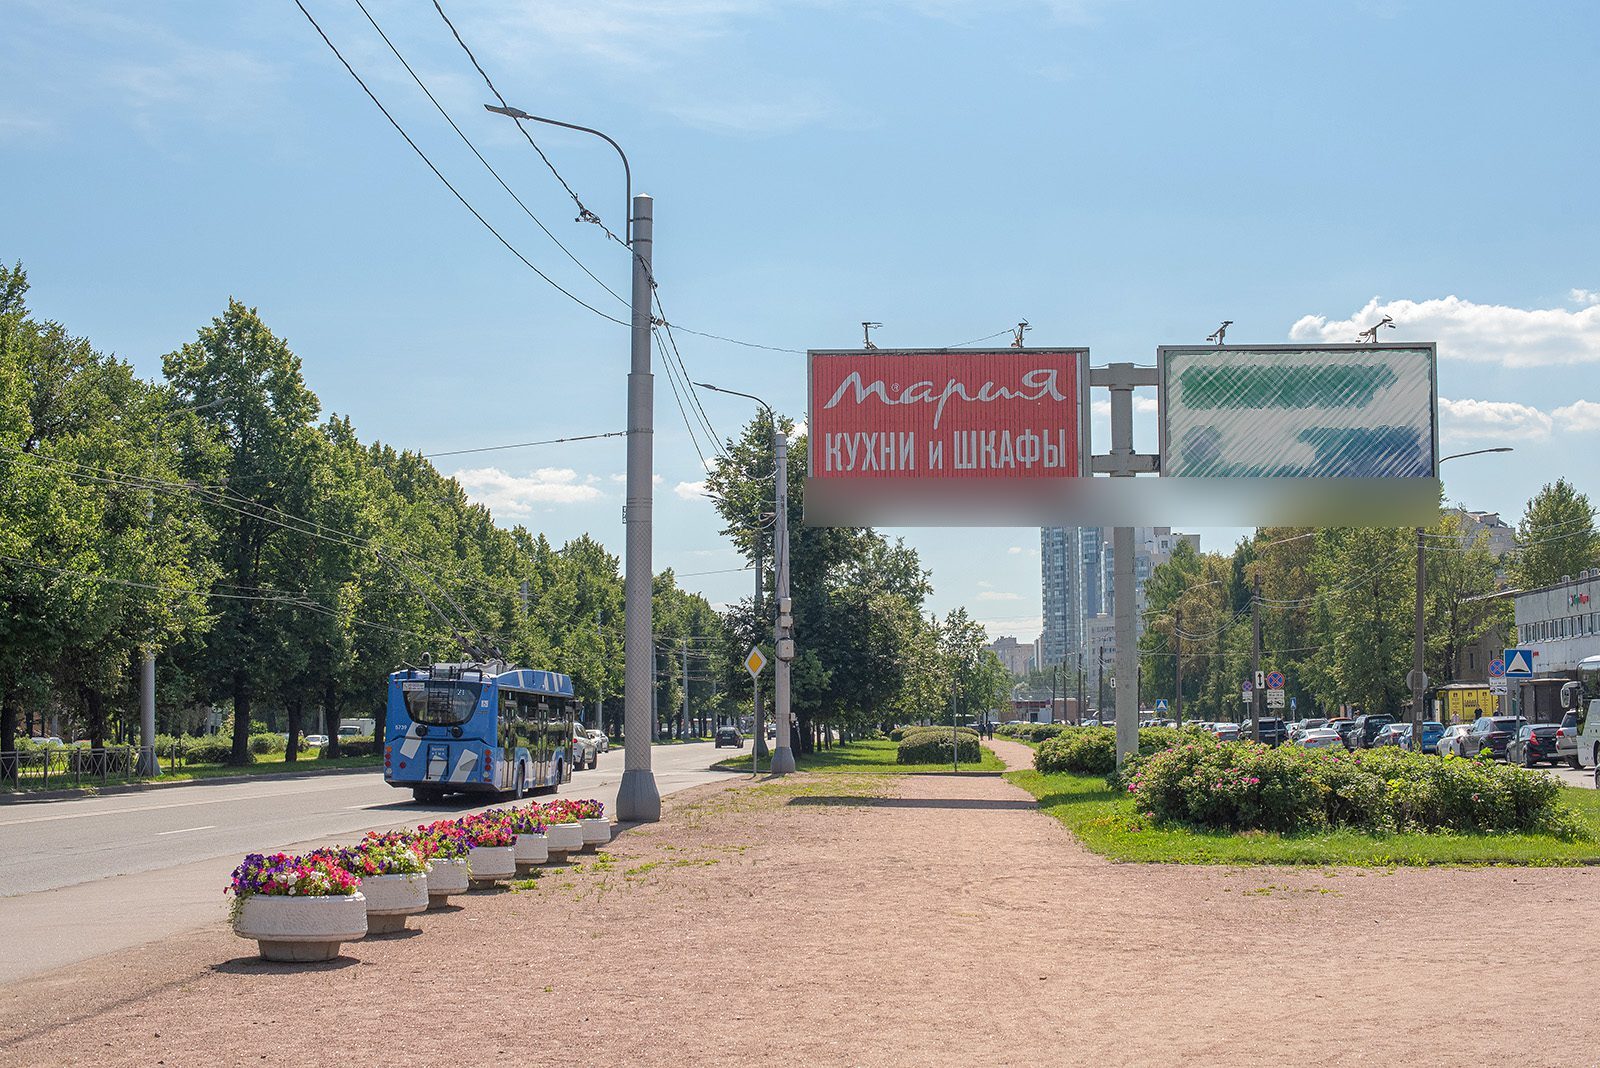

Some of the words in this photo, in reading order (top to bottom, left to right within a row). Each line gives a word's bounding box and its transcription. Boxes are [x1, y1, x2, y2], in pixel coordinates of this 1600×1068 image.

[825, 432, 915, 471] КУХНИ
[928, 440, 943, 470] и
[954, 429, 1066, 470] ШКАФЫ
